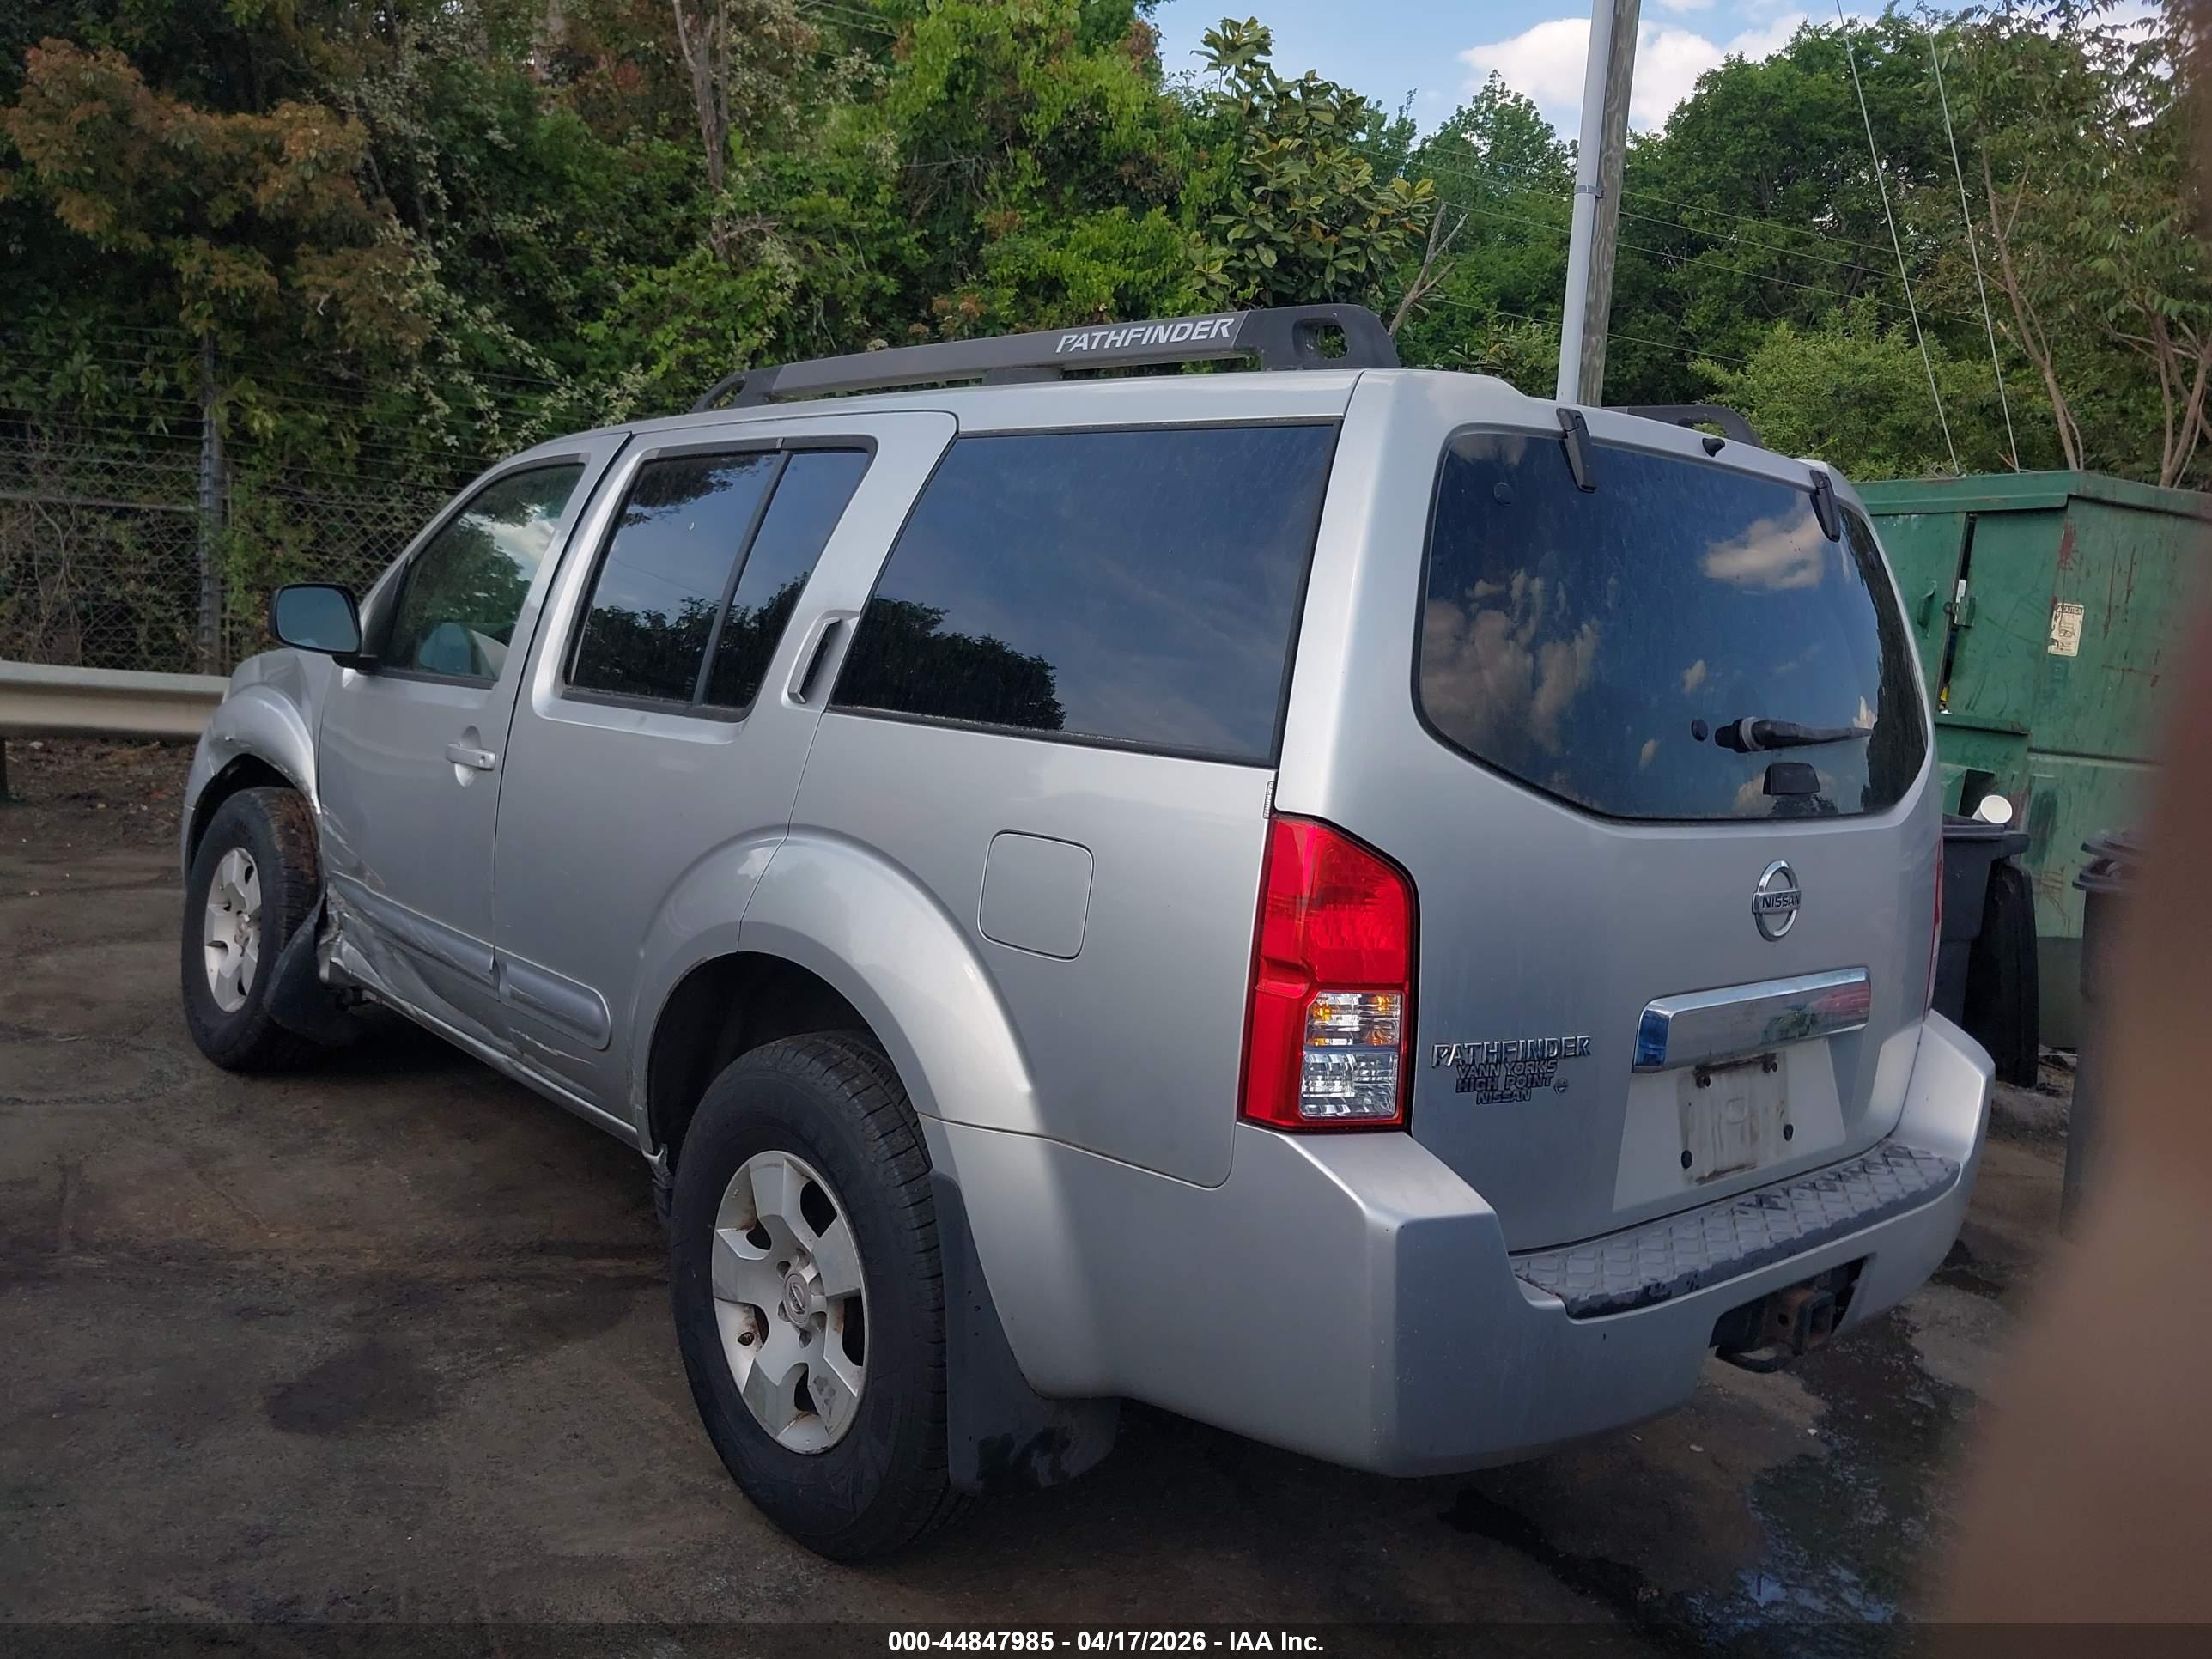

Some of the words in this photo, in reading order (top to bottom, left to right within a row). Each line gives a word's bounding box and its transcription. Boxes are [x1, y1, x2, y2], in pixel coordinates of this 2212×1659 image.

[1055, 318, 1235, 354] PATHFINDER
[1762, 895, 1800, 908] NISSAN
[1431, 1035, 1591, 1068] PATHFINDER
[1456, 1063, 1501, 1079] VANN
[1455, 1077, 1499, 1093] HIGH
[1504, 1073, 1554, 1090] POINT
[1475, 1088, 1532, 1105] NISSAN
